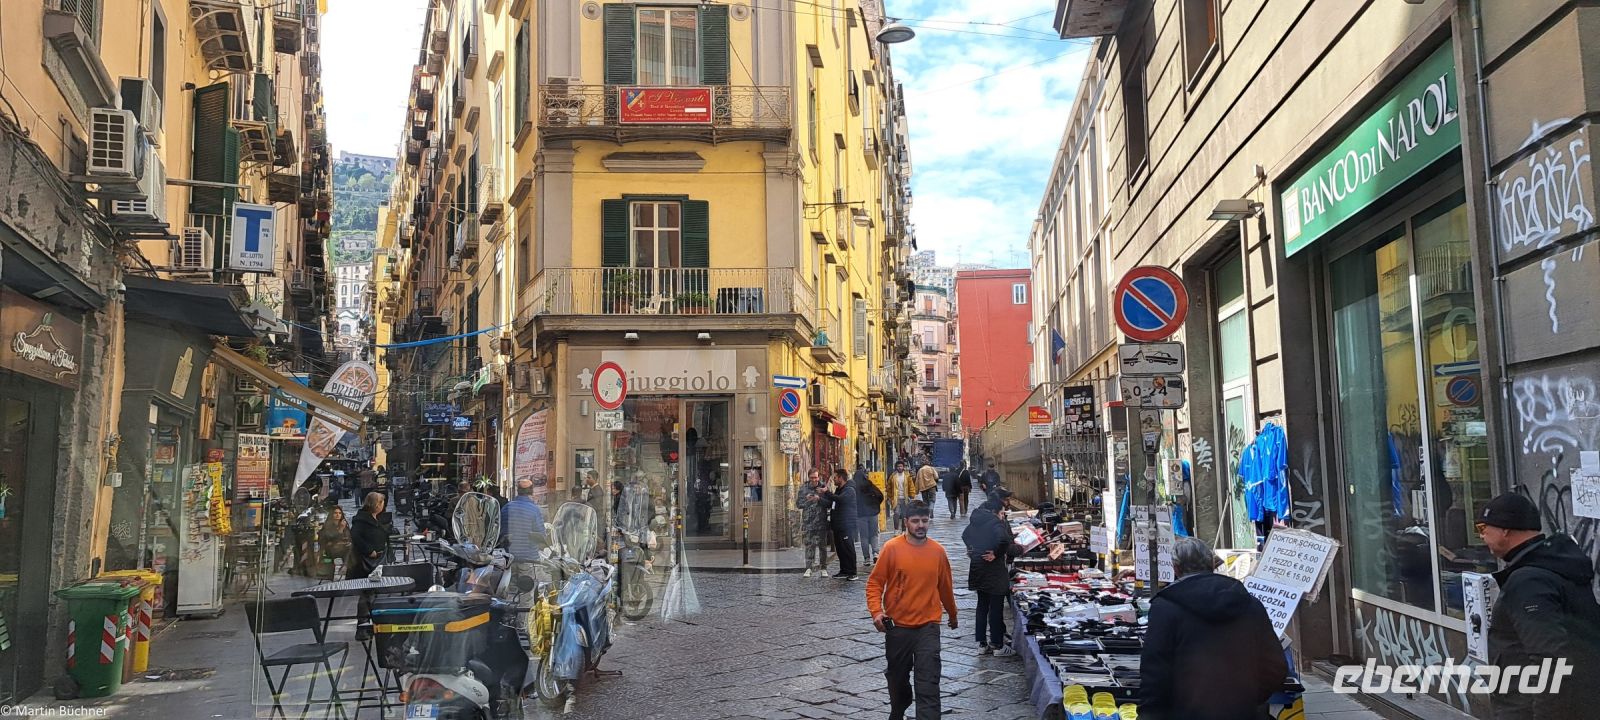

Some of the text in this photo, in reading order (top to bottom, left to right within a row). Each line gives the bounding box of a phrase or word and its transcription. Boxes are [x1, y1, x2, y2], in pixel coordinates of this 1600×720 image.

[1301, 69, 1458, 226] BANCO DI NAPOL
[236, 207, 272, 252] T
[625, 369, 730, 392] iuggiolo
[331, 382, 365, 401] PIZZERIA
[1271, 533, 1327, 553] DOKTOR SCHOLL
[1276, 547, 1297, 557] PEZZO
[1297, 551, 1303, 559] €
[1303, 553, 1319, 563] 5.00
[1138, 569, 1143, 577] 3
[1144, 570, 1150, 578] €
[1267, 566, 1285, 576] PEZZI
[1292, 572, 1311, 583] 15.00
[1271, 557, 1293, 568] PEZZO
[1293, 562, 1299, 570] €
[1298, 563, 1315, 574] 8.00
[1247, 581, 1298, 600] CALZINI FILO
[1257, 594, 1286, 608] SCOZIA
[1269, 608, 1288, 620] 7,00
